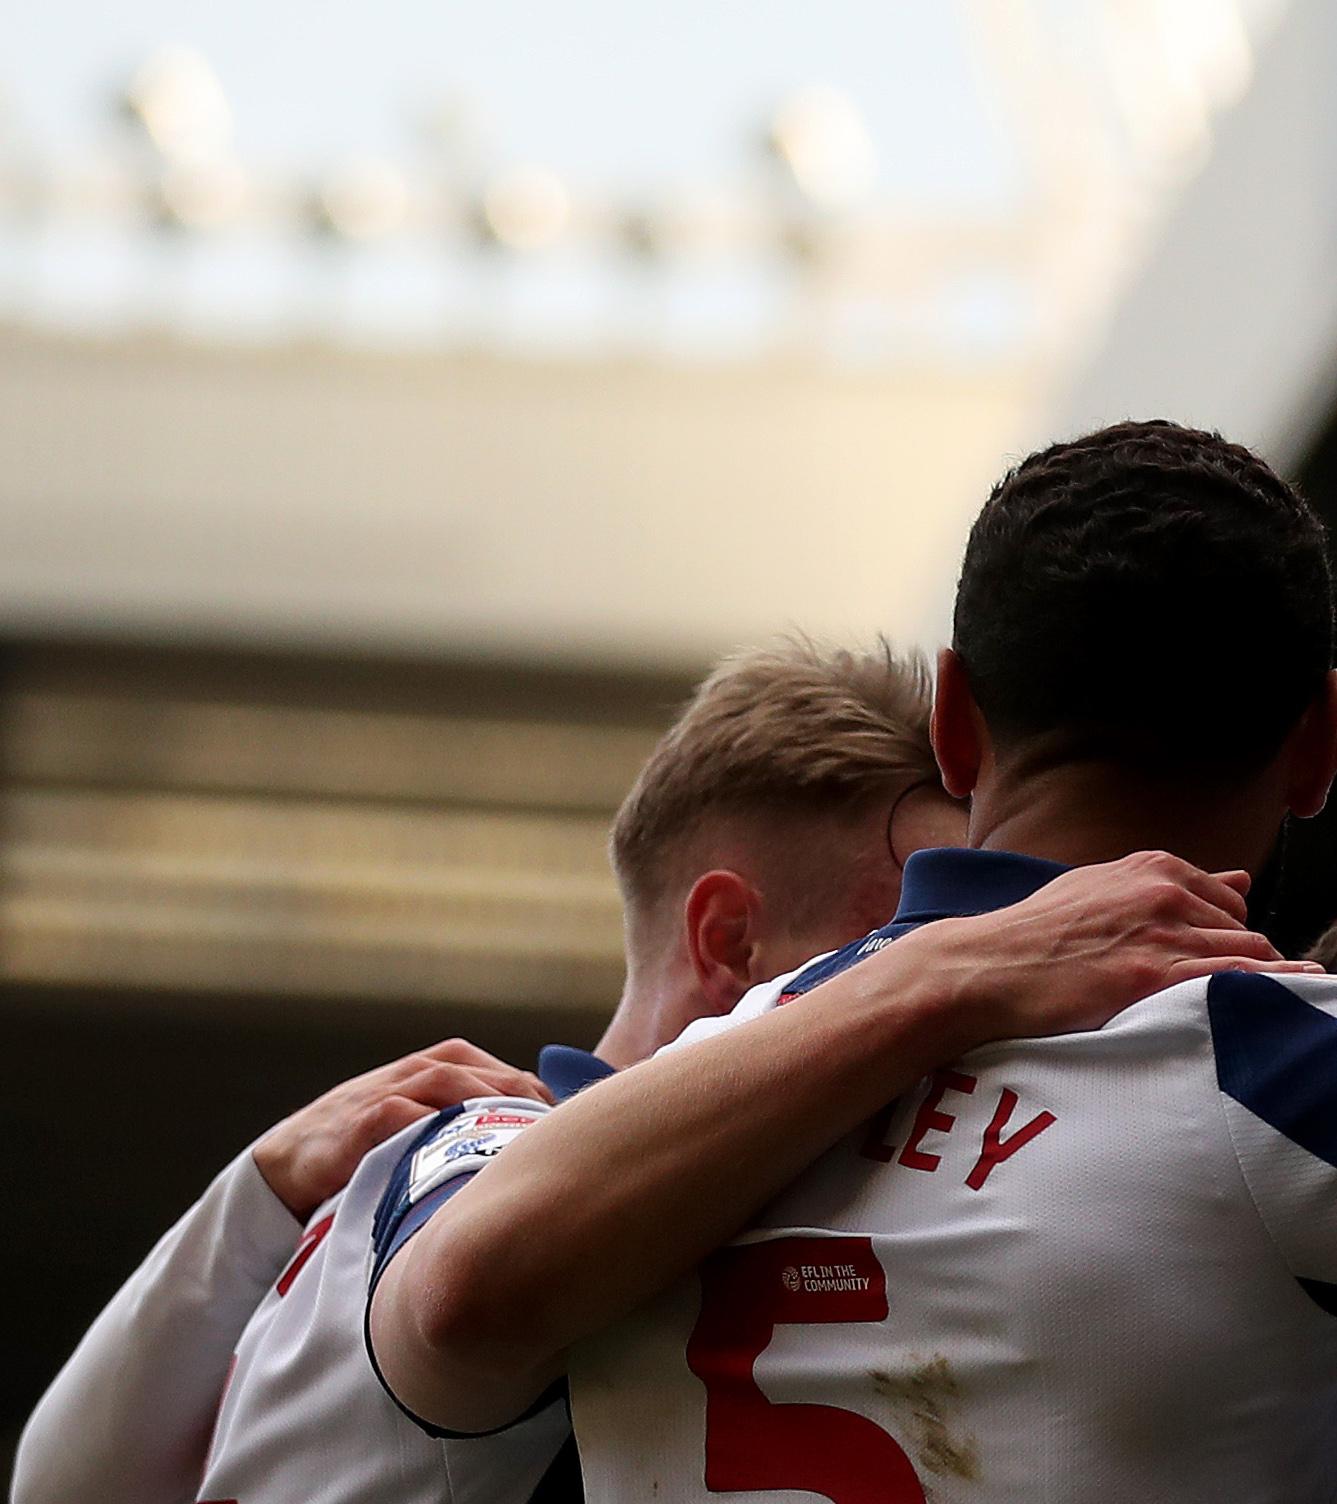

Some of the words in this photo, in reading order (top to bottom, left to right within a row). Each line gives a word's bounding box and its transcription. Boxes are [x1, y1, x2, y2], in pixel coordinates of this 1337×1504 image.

[801, 1265, 821, 1278] EFL
[819, 1265, 834, 1278] IN
[834, 1264, 857, 1277] THE
[804, 1277, 870, 1292] COMMUNITY
